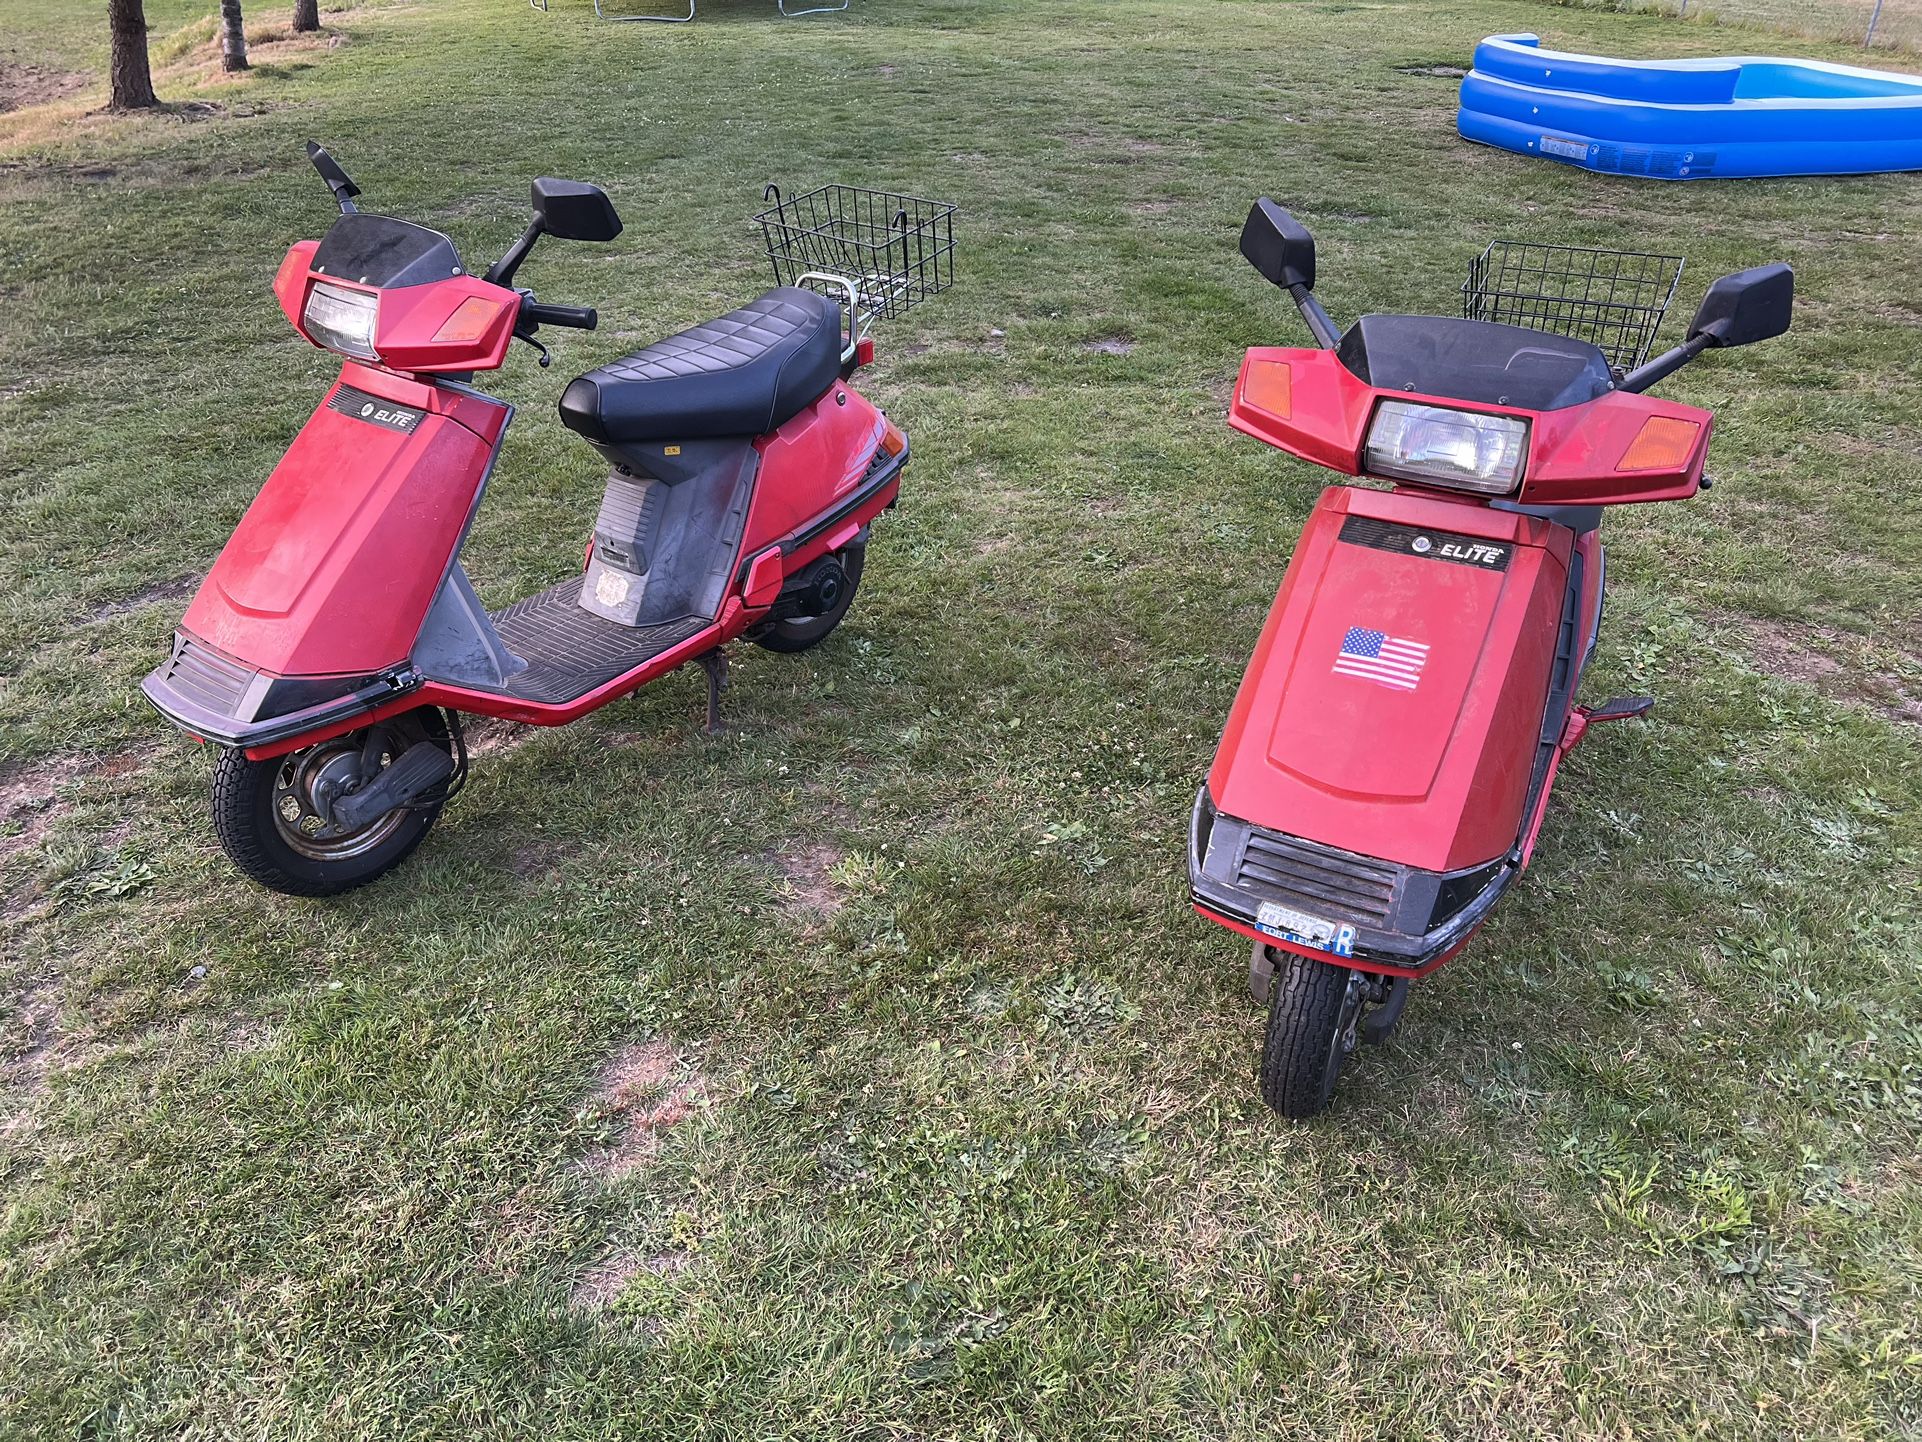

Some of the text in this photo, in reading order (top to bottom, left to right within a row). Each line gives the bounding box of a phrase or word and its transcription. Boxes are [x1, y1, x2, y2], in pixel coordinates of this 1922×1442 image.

[374, 410, 412, 426] ELITE
[1440, 544, 1500, 563] ELITE
[1472, 544, 1504, 554] HONDA
[1292, 935, 1325, 950] LEWIS
